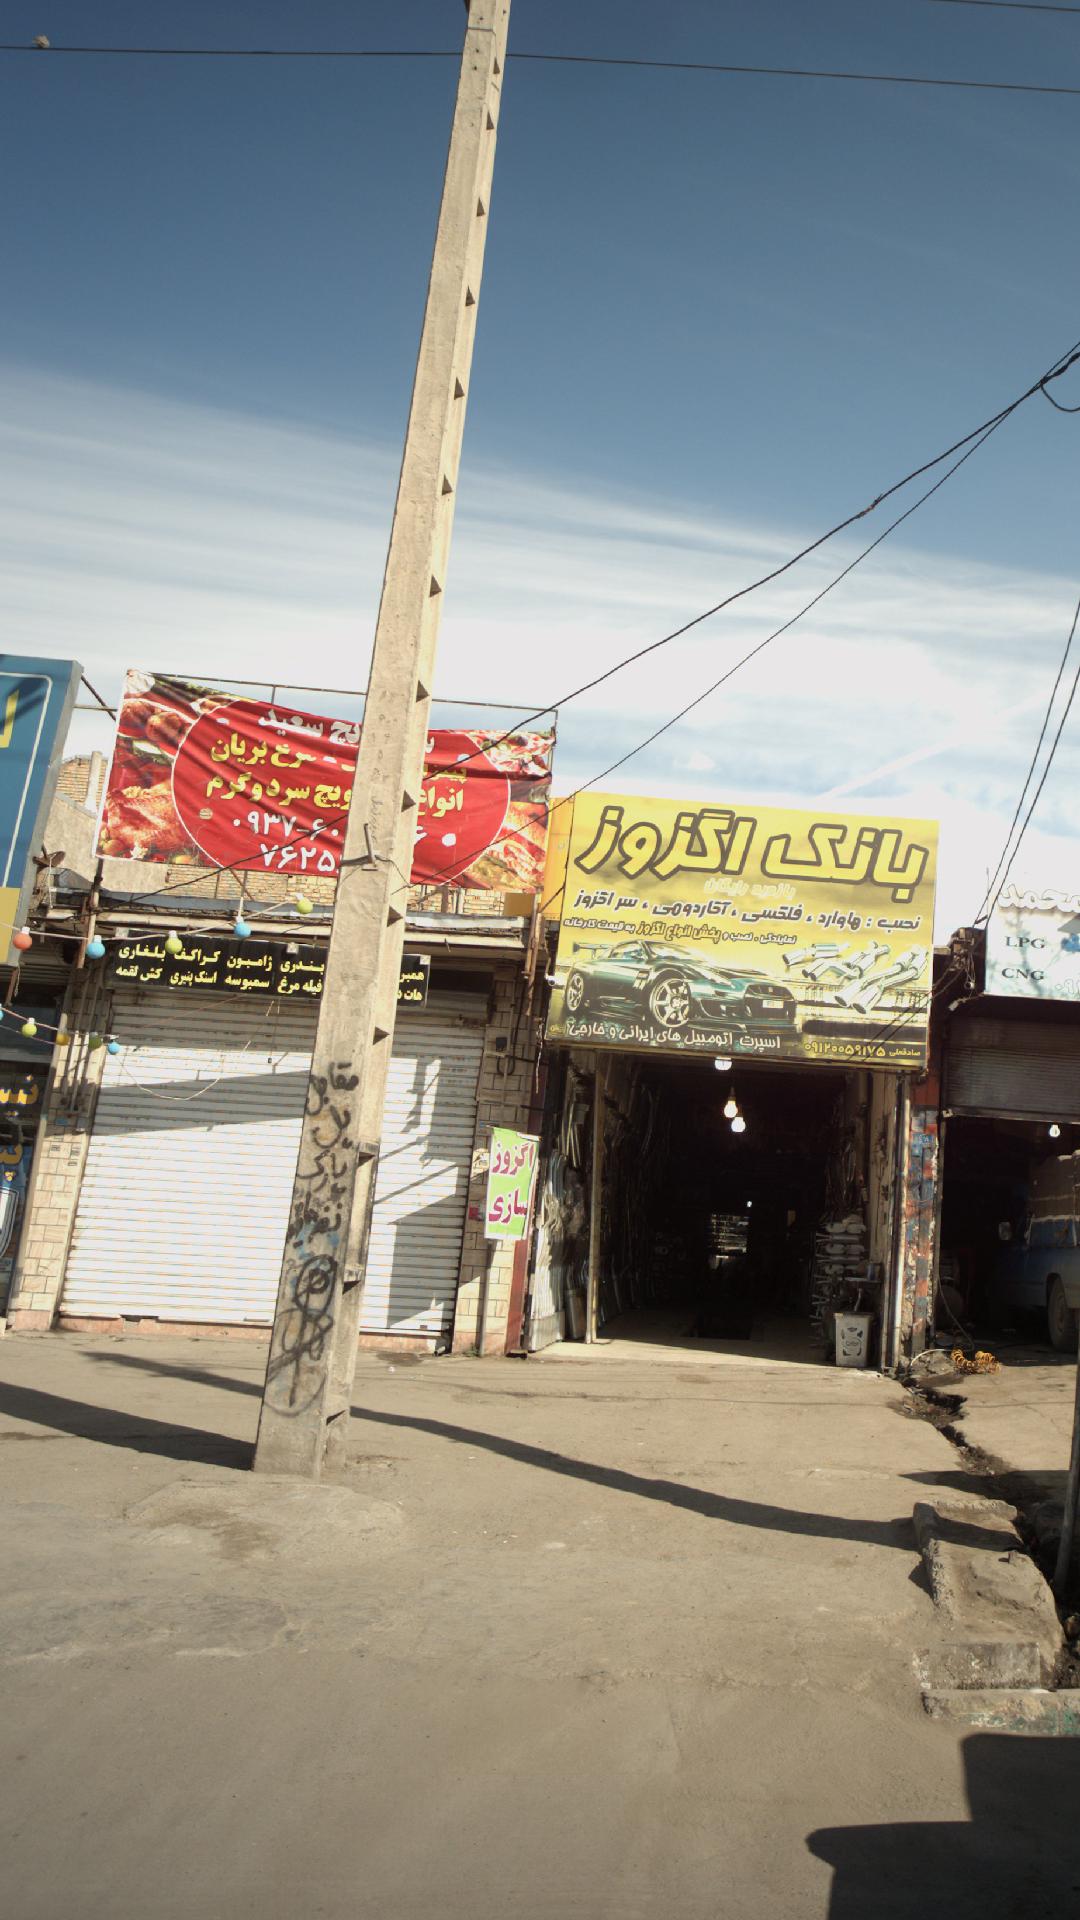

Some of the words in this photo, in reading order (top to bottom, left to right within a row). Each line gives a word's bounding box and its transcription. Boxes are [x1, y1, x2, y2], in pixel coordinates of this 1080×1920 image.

[211, 733, 268, 765] بریان
[206, 772, 252, 800] گرم
[266, 778, 310, 806] سرد
[574, 805, 757, 881] اگزوز
[760, 823, 930, 904] بانک
[614, 897, 638, 912] سر
[664, 924, 693, 941] انواع
[877, 916, 921, 933] نصب
[729, 931, 754, 942] نصب
[1004, 936, 1046, 949] LPG
[118, 943, 166, 962] بلغاری
[226, 953, 273, 971] ژامبون
[280, 959, 325, 976] بندری
[224, 974, 270, 990] سمبوسه
[399, 971, 425, 983] همبر
[1001, 967, 1045, 981] CNG
[277, 979, 300, 994] مرغ
[302, 978, 323, 996] فیله
[568, 1021, 605, 1037] خارجی
[618, 1024, 654, 1042] ایرانی
[656, 1027, 681, 1043] های
[684, 1029, 733, 1047] اتومبیل
[739, 1035, 781, 1053] اسپرت
[491, 1142, 535, 1175] اگزوز
